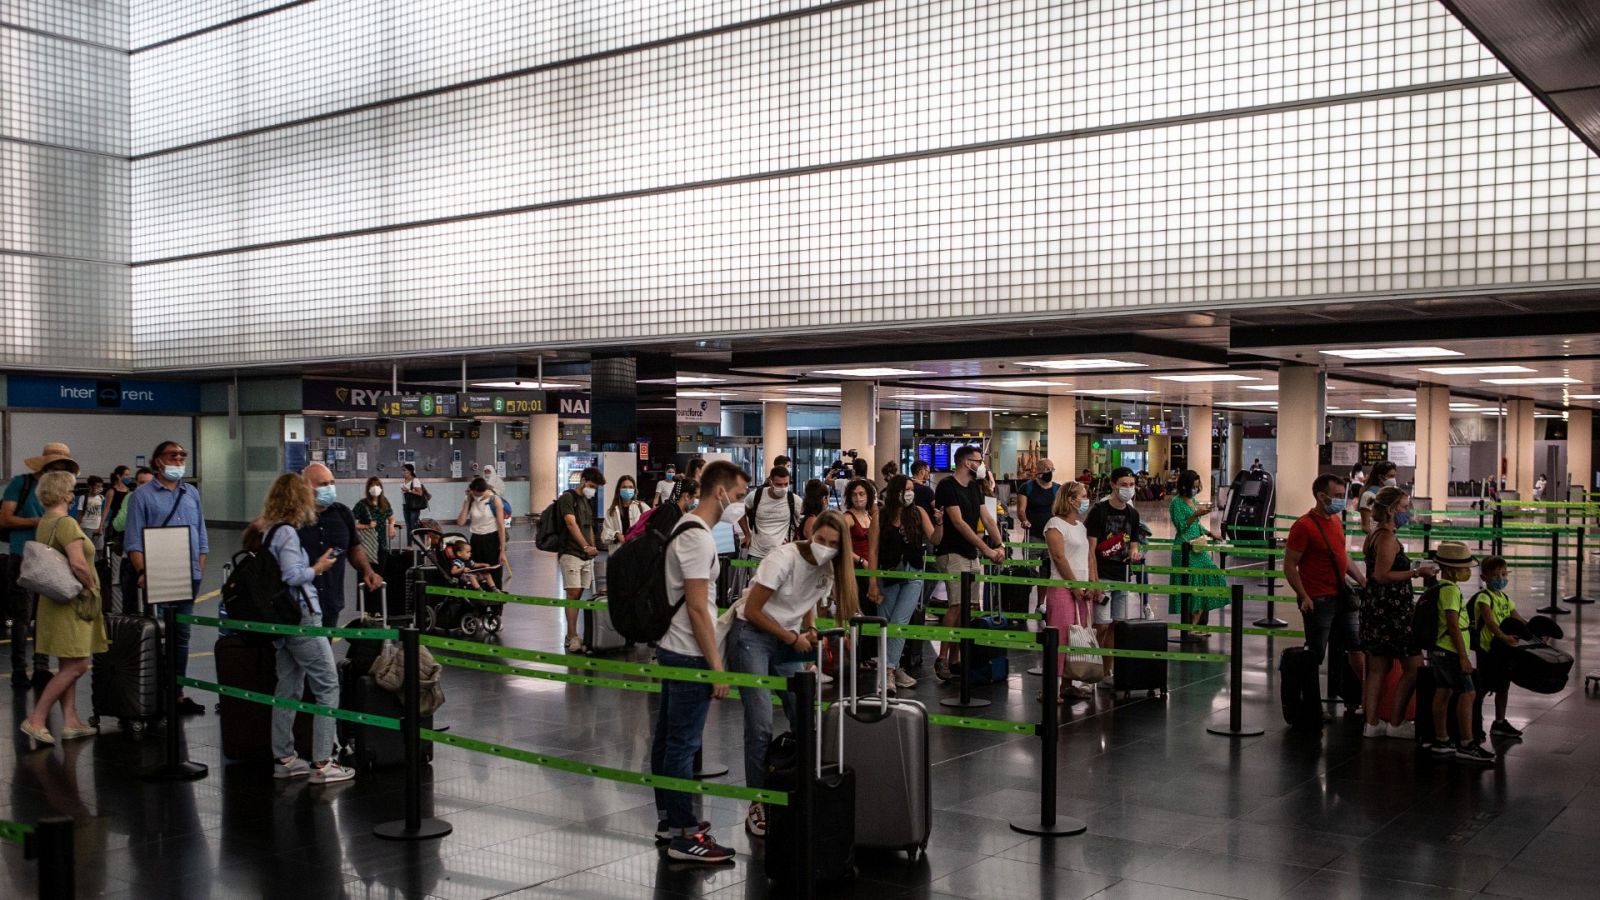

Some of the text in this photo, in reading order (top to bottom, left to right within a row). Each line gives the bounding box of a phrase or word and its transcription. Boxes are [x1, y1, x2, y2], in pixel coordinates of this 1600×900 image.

[60, 385, 154, 401] inter rent
[424, 399, 431, 411] B
[516, 400, 542, 412] 70.01
[326, 427, 335, 436] 60
